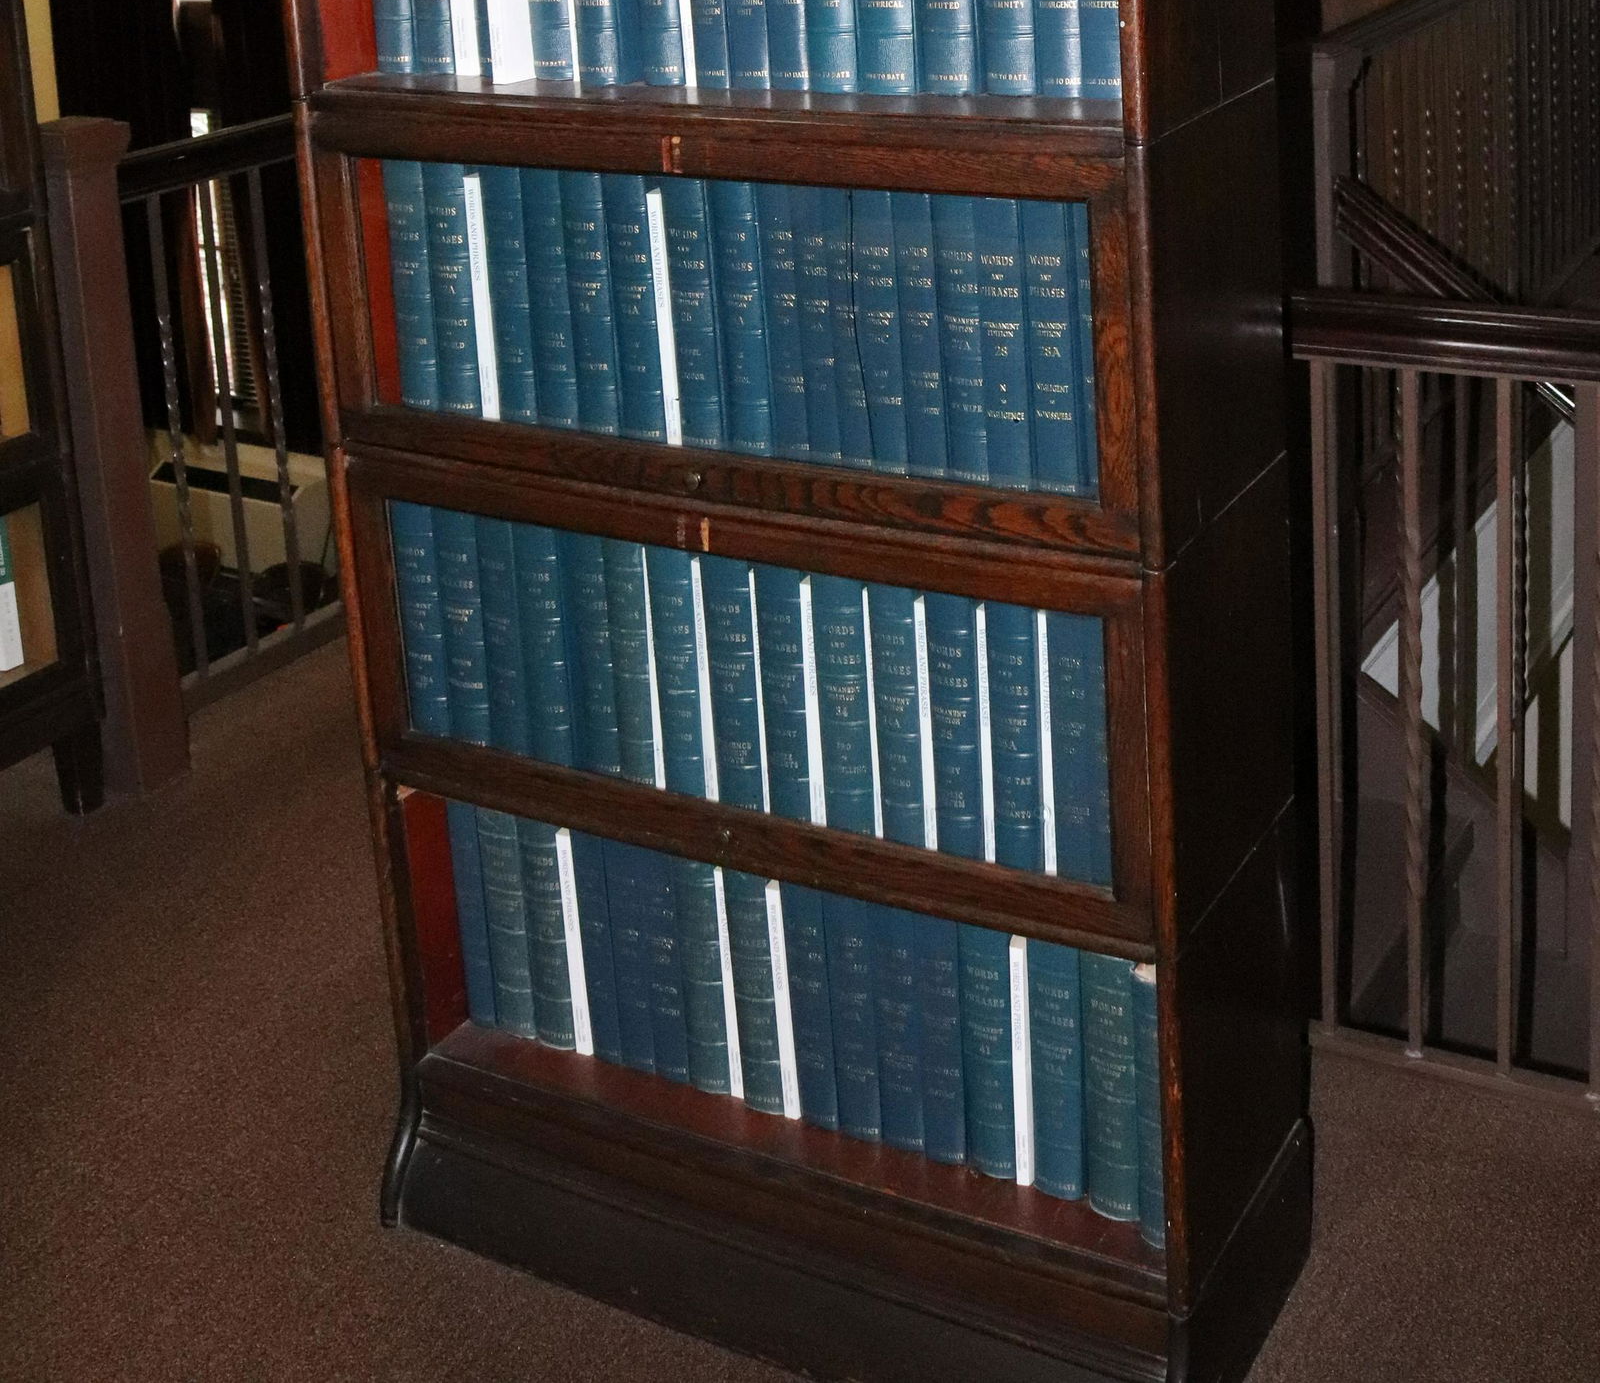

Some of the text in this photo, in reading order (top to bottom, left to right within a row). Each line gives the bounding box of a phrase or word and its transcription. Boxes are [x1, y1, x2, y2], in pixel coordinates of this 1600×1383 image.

[468, 189, 476, 219] WORDS
[472, 241, 480, 281] PHRASES
[650, 211, 658, 243] WORDS
[655, 268, 664, 307] PHRASES
[981, 255, 1014, 266] WORDS
[1030, 255, 1061, 266] WORDS
[981, 286, 1018, 298] PHRASES
[1029, 286, 1065, 298] PHRASES
[995, 346, 1008, 356] 28
[1000, 384, 1006, 392] N
[918, 620, 926, 655] WORDS
[920, 679, 928, 717] PHRASES
[967, 965, 999, 980] WORDS
[1091, 999, 1123, 1016] WORDS
[1014, 1014, 1022, 1050] PHRASES
